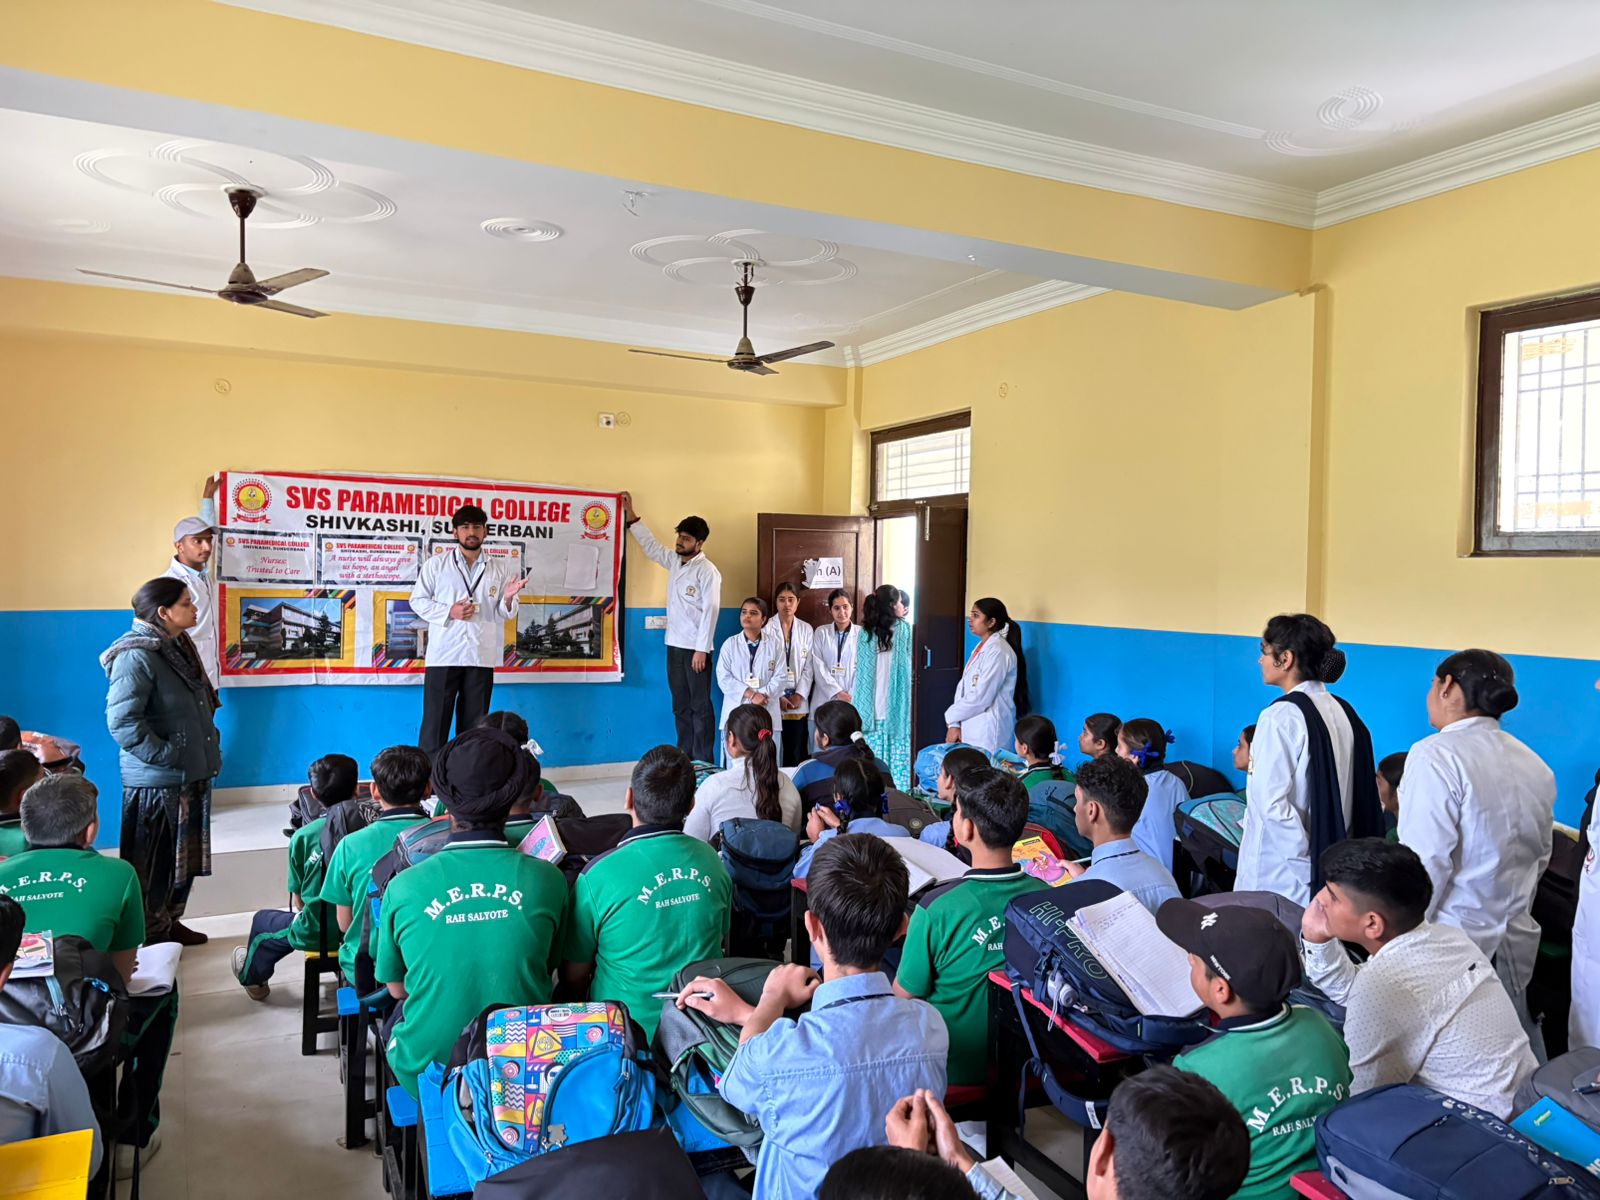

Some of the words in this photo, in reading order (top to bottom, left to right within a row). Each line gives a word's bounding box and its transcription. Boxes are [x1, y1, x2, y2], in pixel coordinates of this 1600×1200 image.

[286, 485, 332, 511] SVS
[490, 498, 571, 523] COLLEGE
[305, 514, 426, 535] SHIVKASHI,
[432, 520, 554, 539] SUERBANI
[250, 538, 287, 547] PARAMEDICAL
[329, 554, 337, 562] A
[357, 554, 372, 562] will
[372, 555, 397, 564] always
[246, 565, 274, 574] Trusted
[275, 566, 283, 574] to
[284, 566, 301, 575] Care
[380, 564, 400, 573] angel
[826, 565, 841, 577] (A)
[637, 867, 712, 906] M.E.R.P.S.
[11, 894, 26, 902] AH
[26, 891, 65, 901] SALYOTE
[423, 882, 523, 921] M.E.R.P.S.
[655, 899, 670, 909] RAH
[670, 892, 700, 906] SALYOTE
[445, 913, 466, 924] RAH
[467, 909, 509, 922] SALYOTE
[987, 942, 1004, 951] RAH
[1272, 1121, 1296, 1137] RAH
